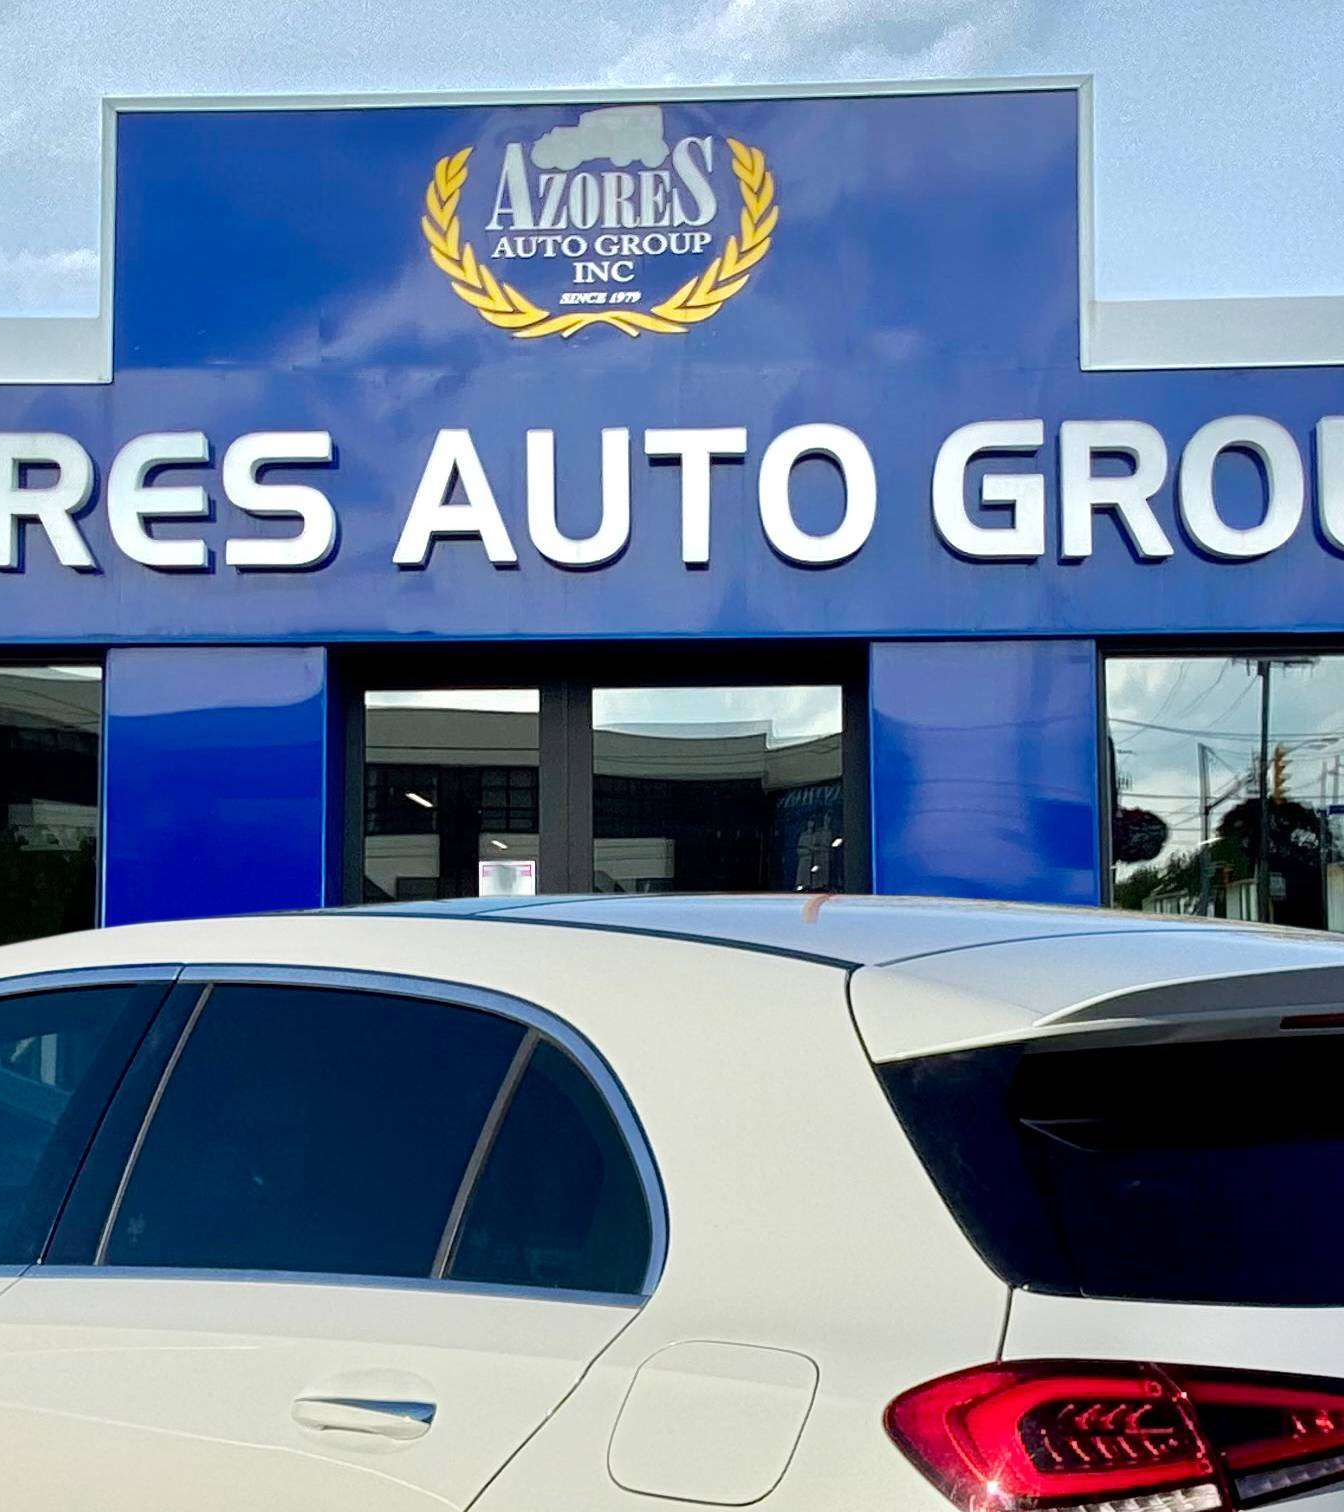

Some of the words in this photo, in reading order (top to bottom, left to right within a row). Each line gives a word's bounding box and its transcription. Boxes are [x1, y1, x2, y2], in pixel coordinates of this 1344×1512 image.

[485, 136, 718, 231] AZORES
[491, 234, 588, 259] AUTO
[594, 232, 713, 257] GROUP
[572, 261, 635, 284] INC
[559, 292, 608, 305] SINCE
[608, 291, 642, 304] 1979
[393, 422, 878, 567] AUTO
